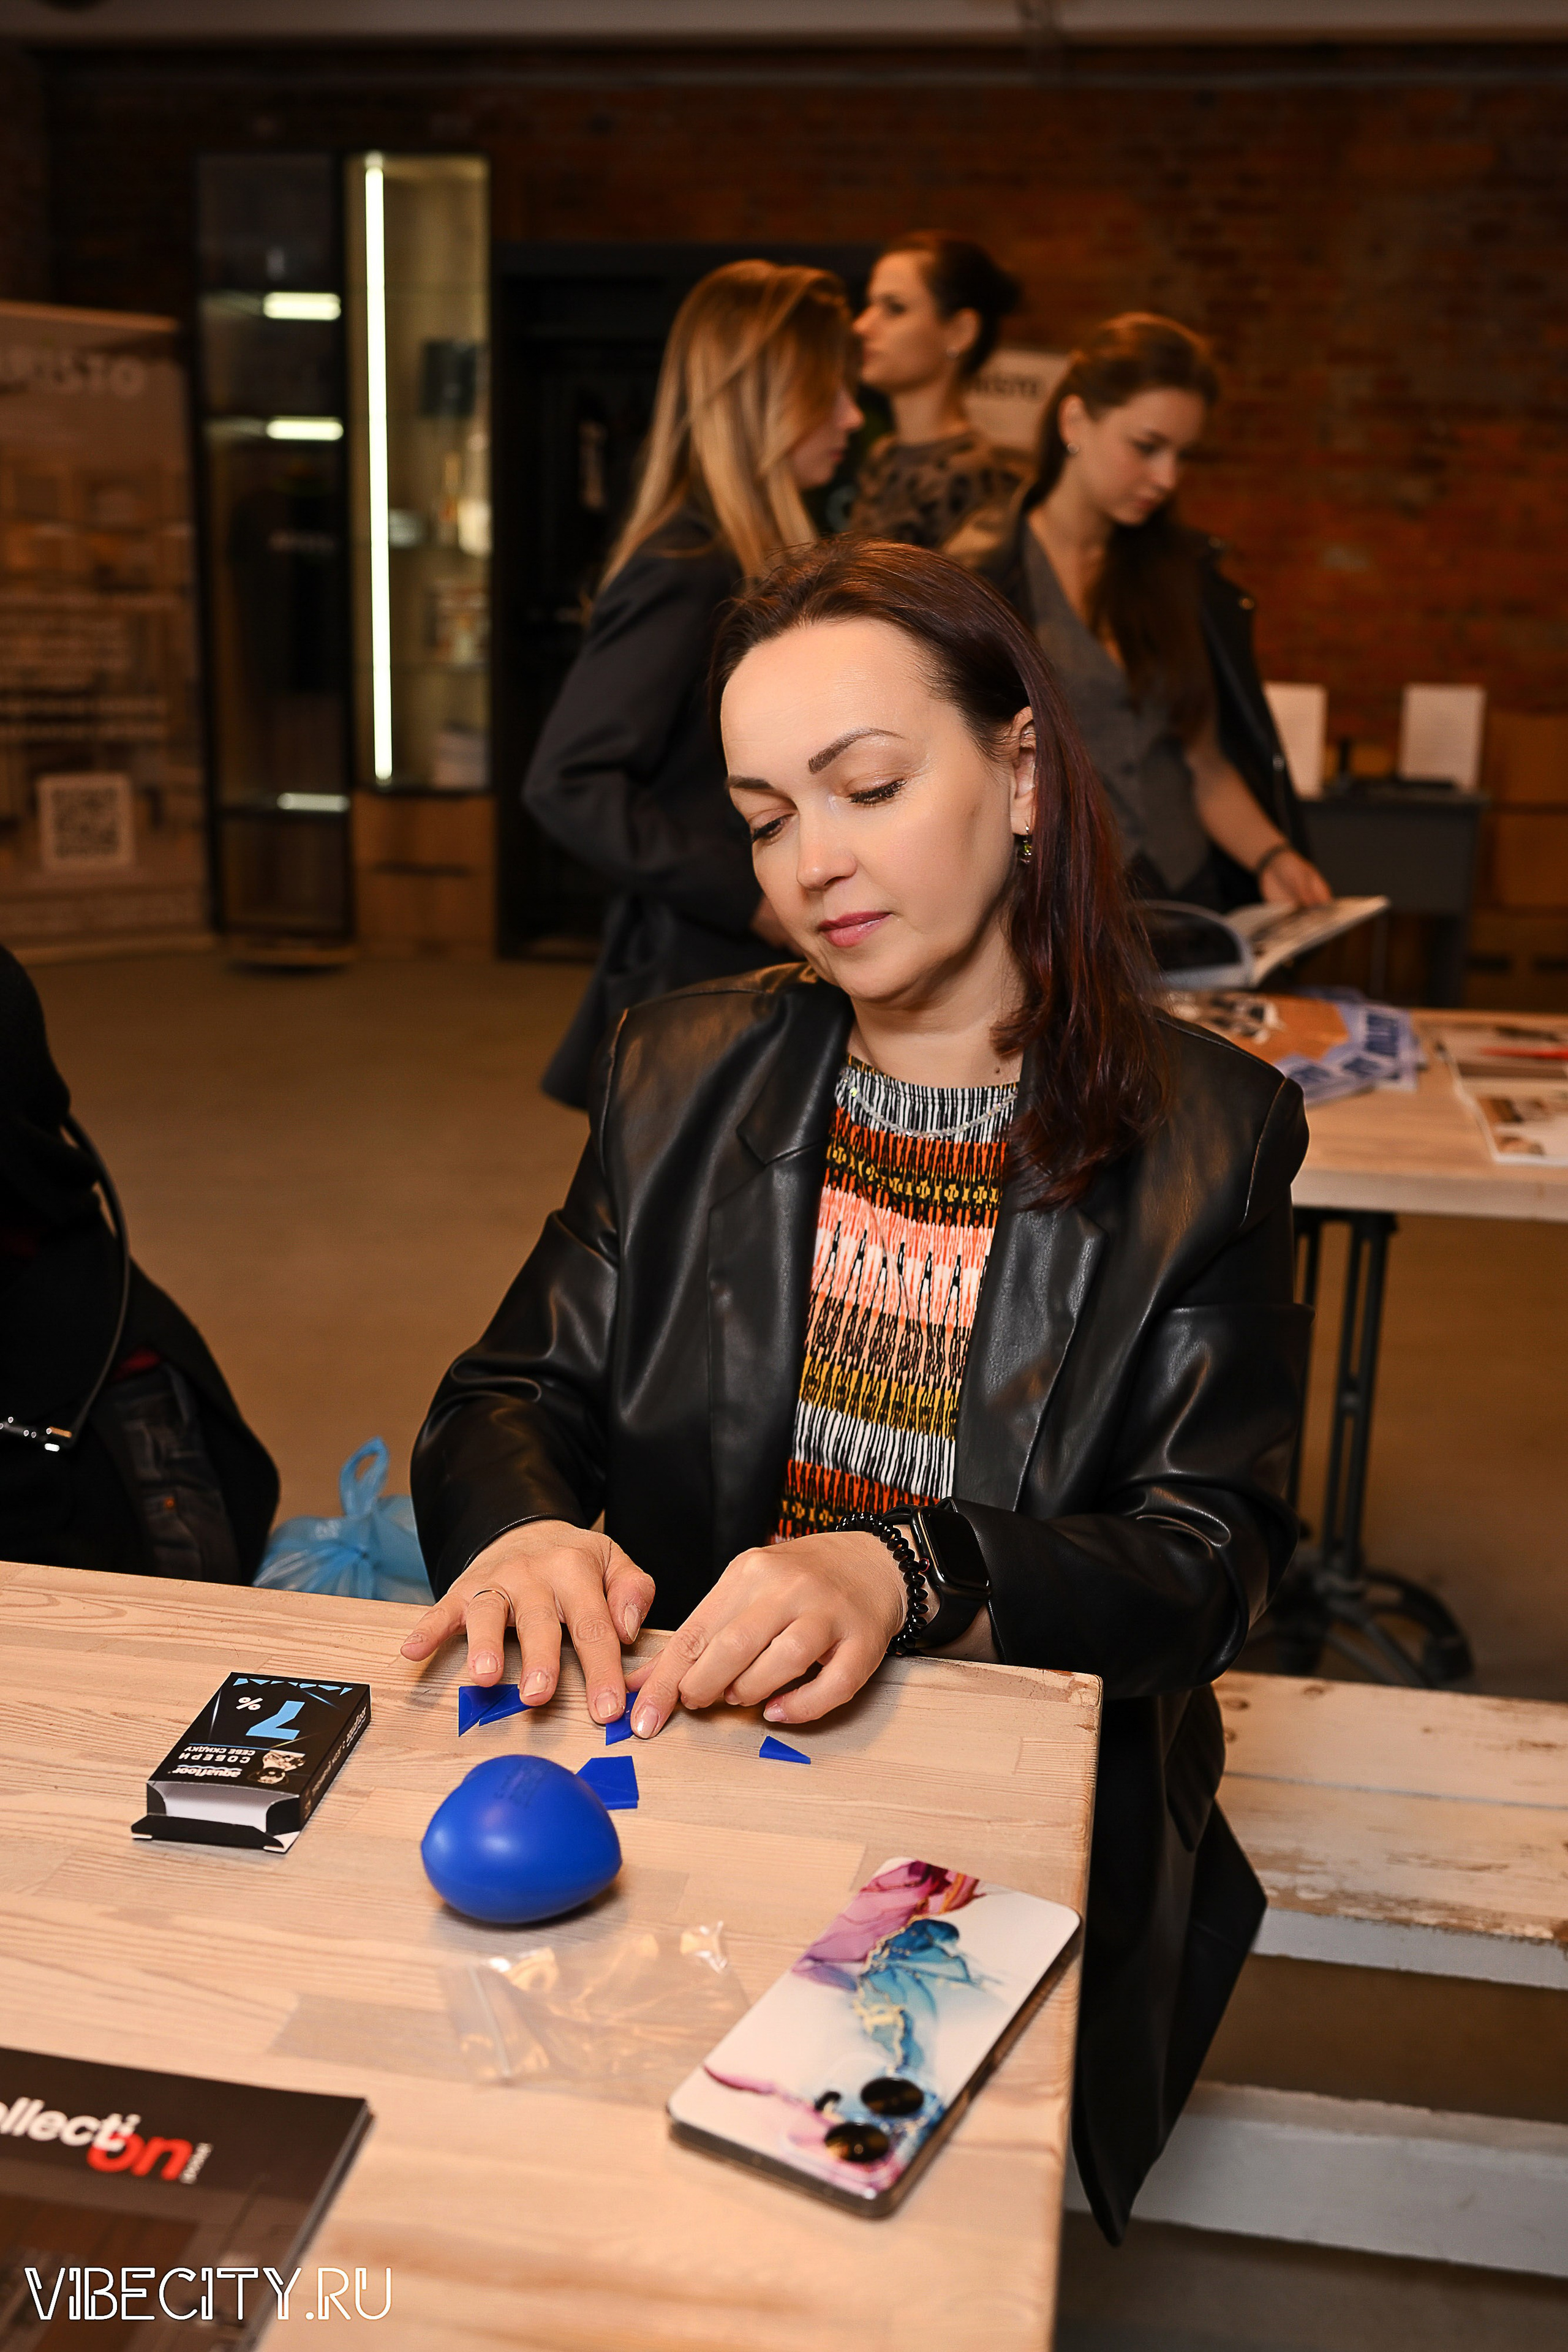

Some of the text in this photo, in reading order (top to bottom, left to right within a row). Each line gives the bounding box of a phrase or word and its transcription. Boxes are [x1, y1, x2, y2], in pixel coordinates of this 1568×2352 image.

[227, 1748, 256, 1757] СЕБЕ
[178, 1752, 251, 1764] СОБЕРИ
[172, 1767, 241, 1777] aquafloor
